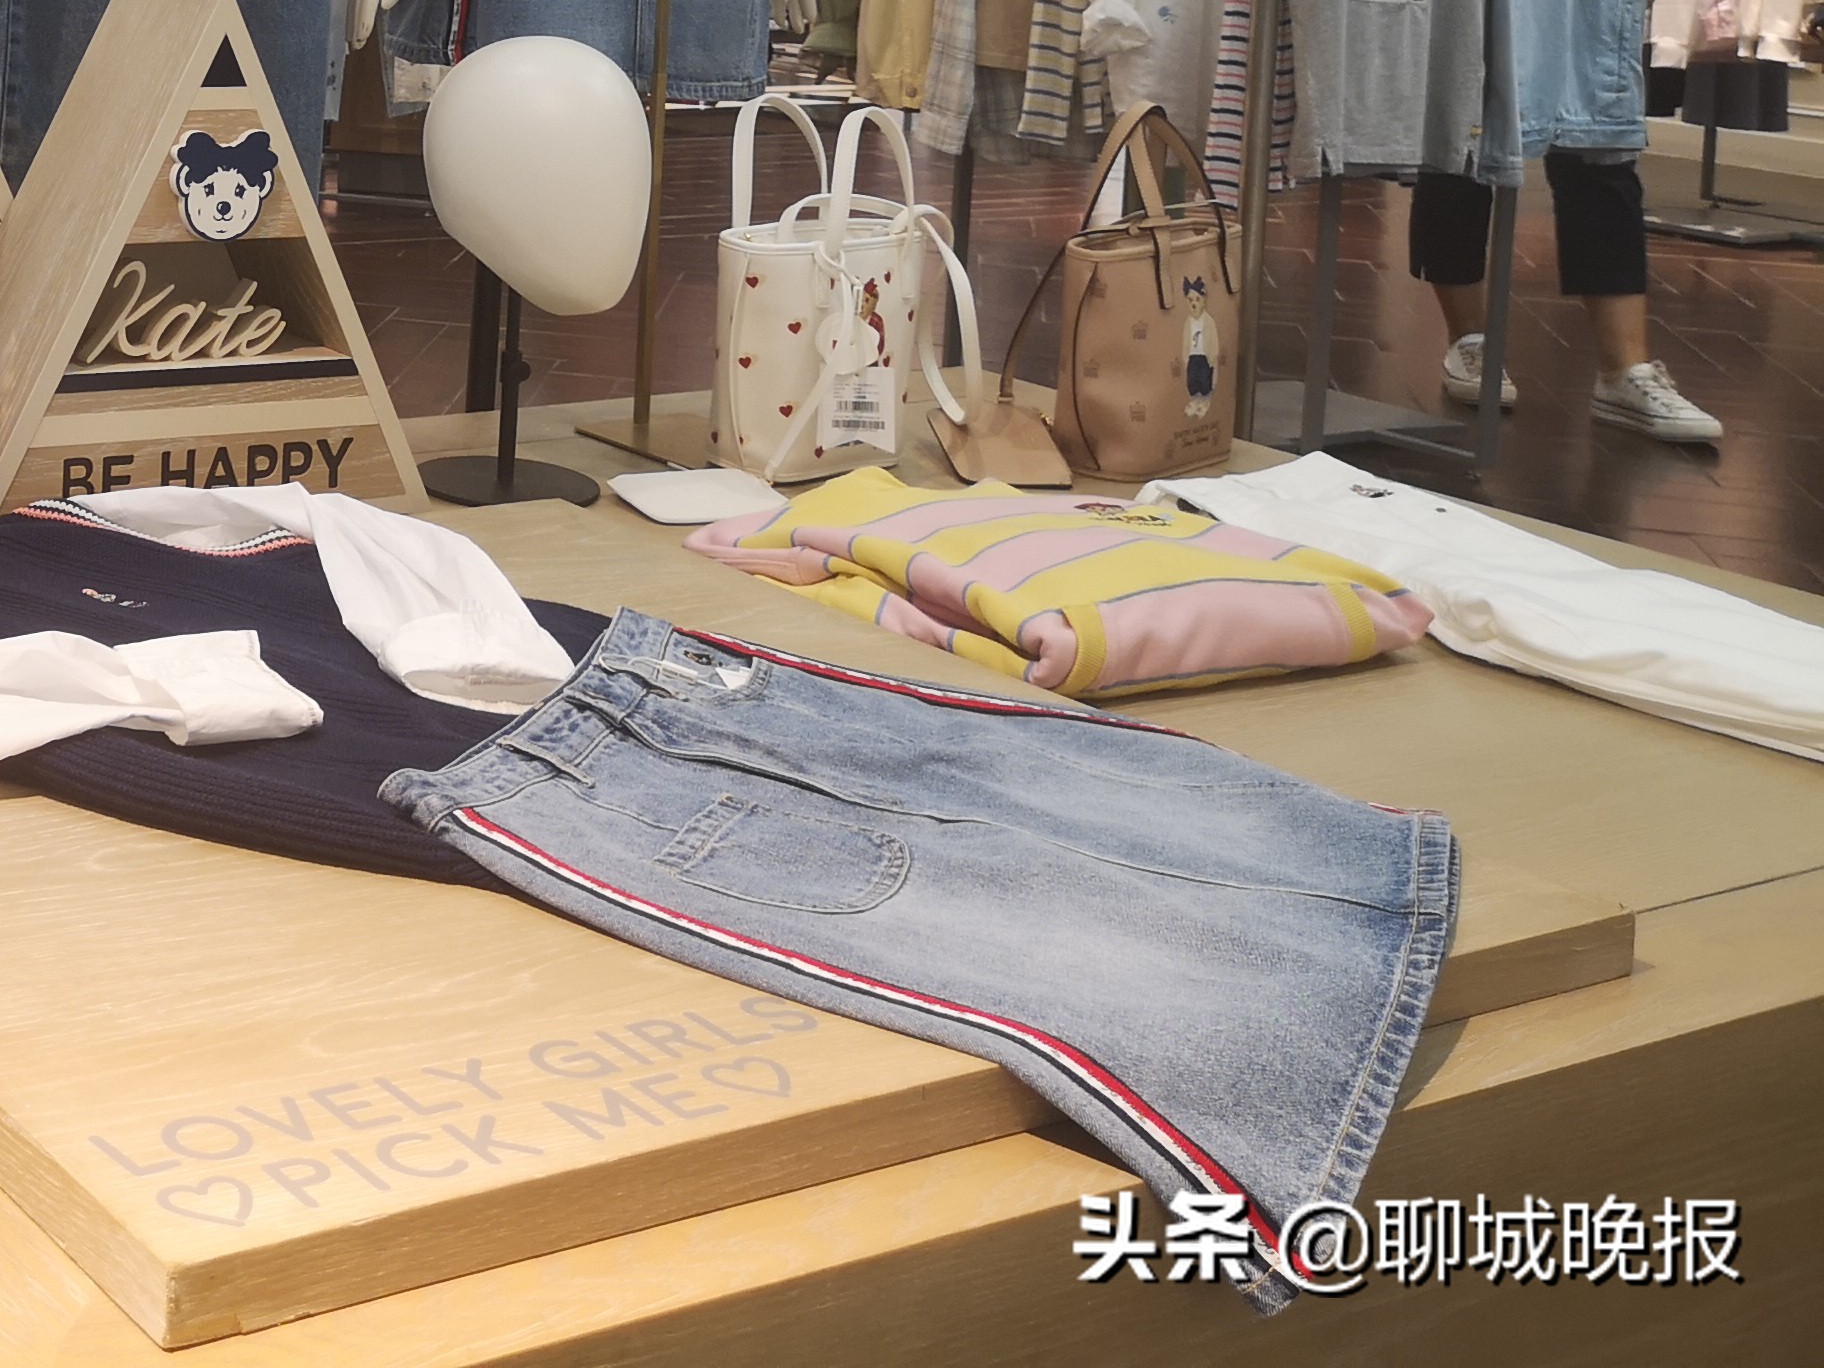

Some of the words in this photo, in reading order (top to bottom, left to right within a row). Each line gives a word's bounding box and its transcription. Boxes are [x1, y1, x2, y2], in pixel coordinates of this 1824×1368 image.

[84, 259, 288, 365] Kate
[62, 455, 135, 498] BE
[161, 436, 355, 489] HAPPY
[88, 1056, 503, 1179] LOVELY
[528, 994, 820, 1080] GIRLS
[260, 1114, 544, 1210] PICK
[544, 1072, 730, 1141] ME
